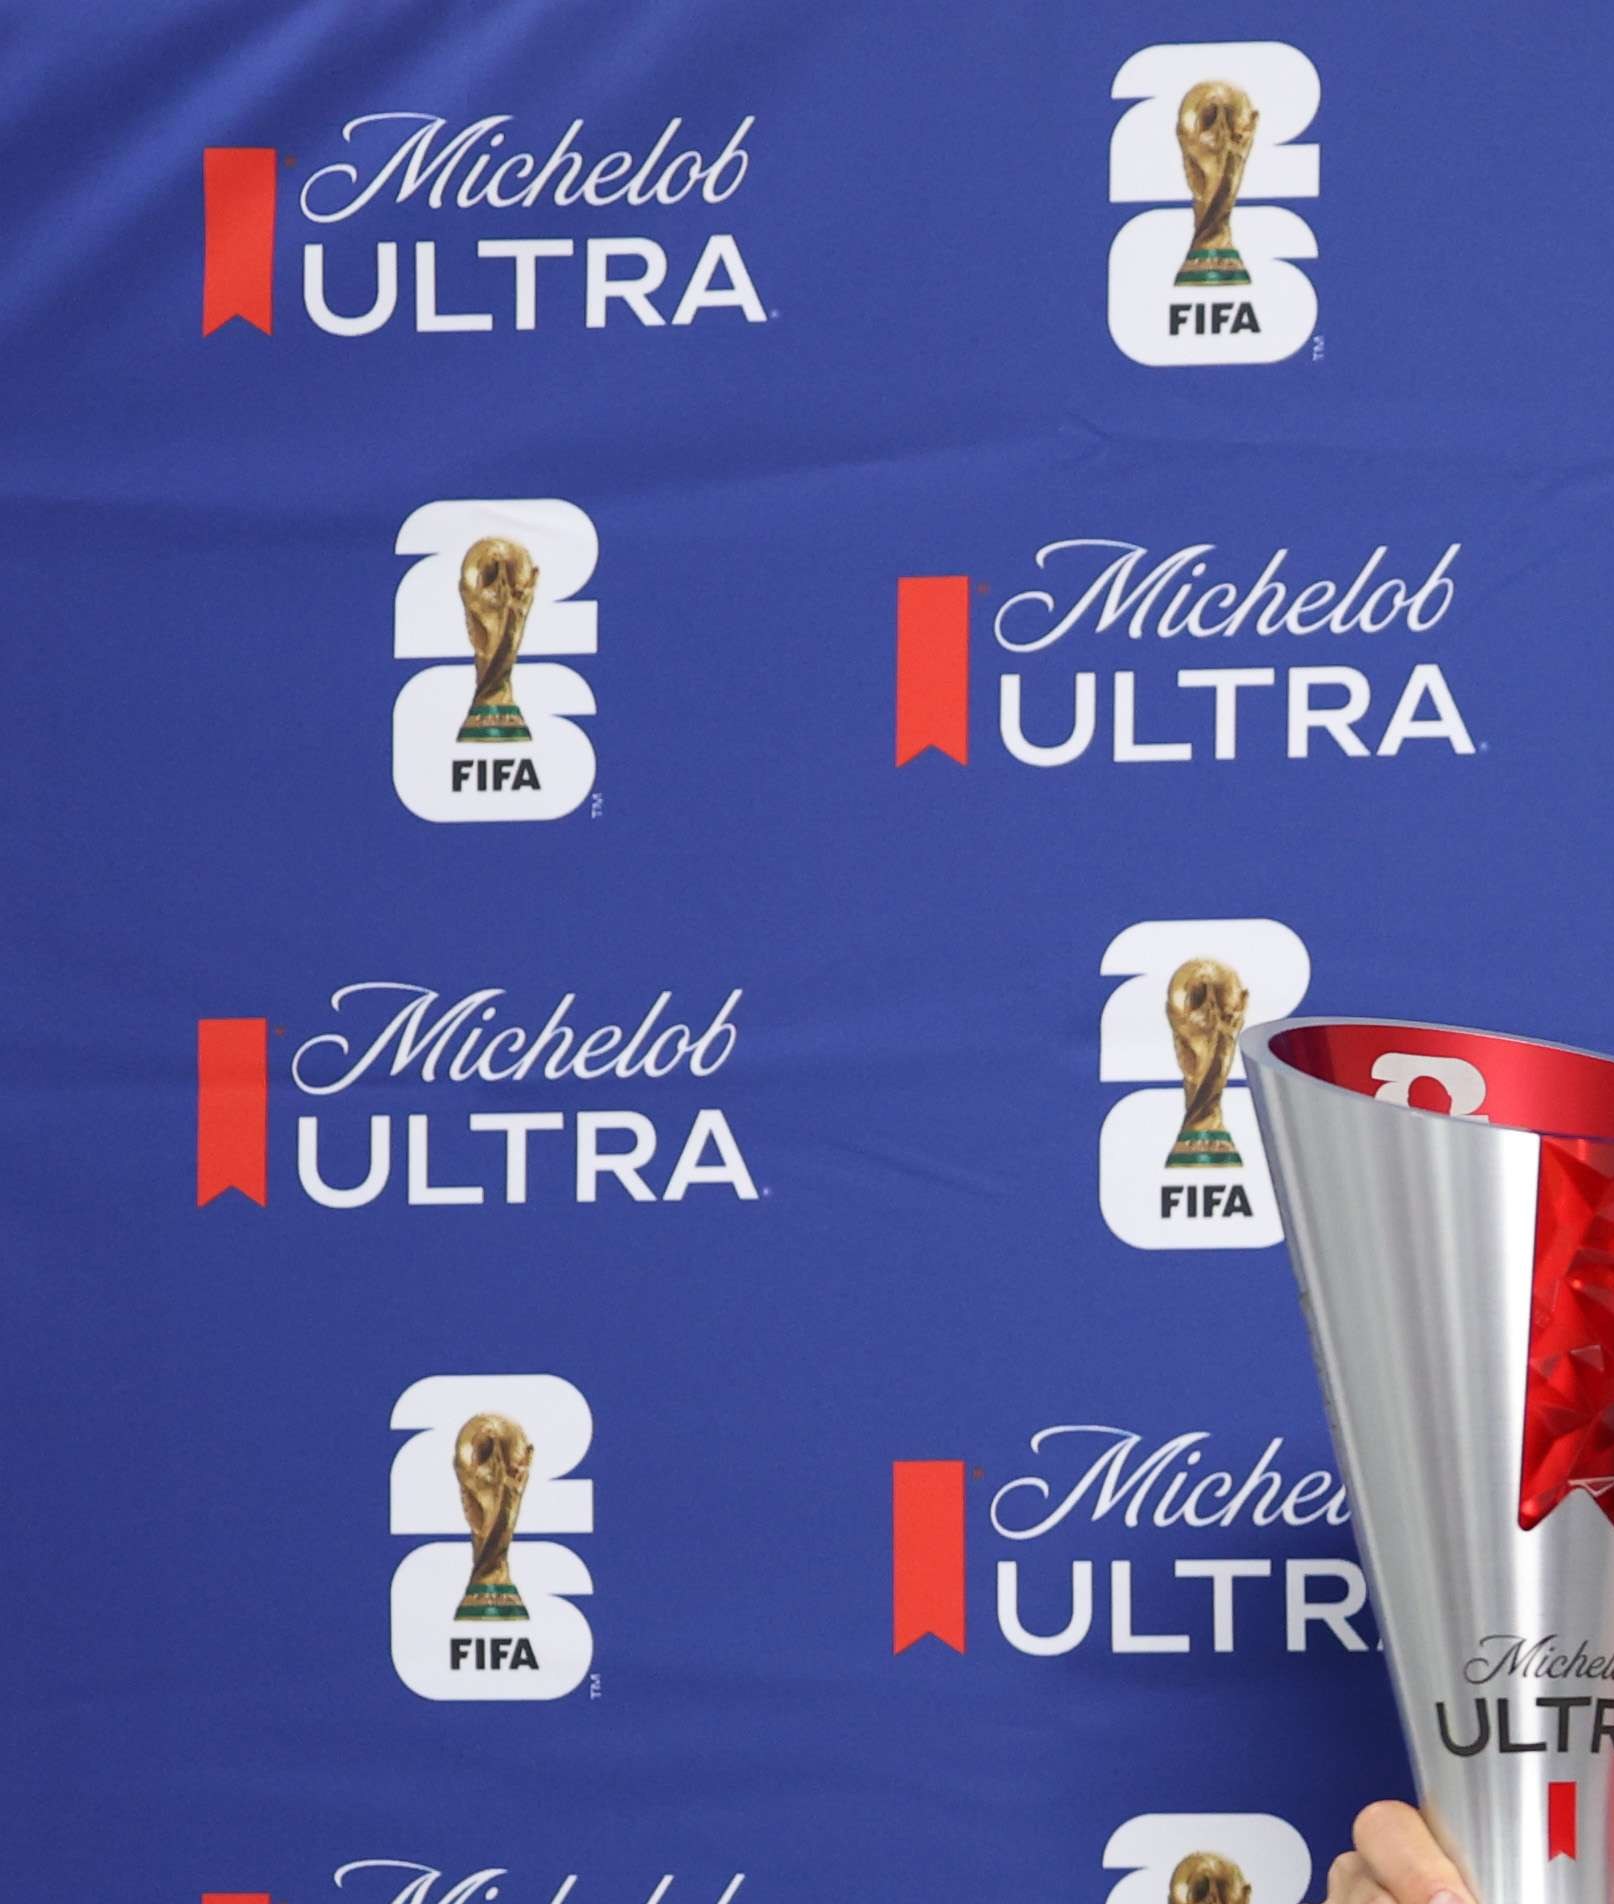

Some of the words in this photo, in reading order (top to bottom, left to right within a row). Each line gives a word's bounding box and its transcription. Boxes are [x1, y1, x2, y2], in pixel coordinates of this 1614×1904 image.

[300, 112, 755, 223] Michelob
[304, 235, 767, 336] ULTRA
[1169, 302, 1261, 336] FIFA
[994, 539, 1461, 653] Michelob
[1000, 664, 1476, 767] ULTRA
[452, 758, 541, 792] FIFA
[292, 982, 743, 1095] Michelob
[298, 1109, 759, 1208] ULTRA
[1160, 1184, 1254, 1219] FIFA
[990, 1424, 1352, 1540] Miche
[450, 1637, 540, 1670] FIFA
[997, 1558, 1384, 1656] ULTR
